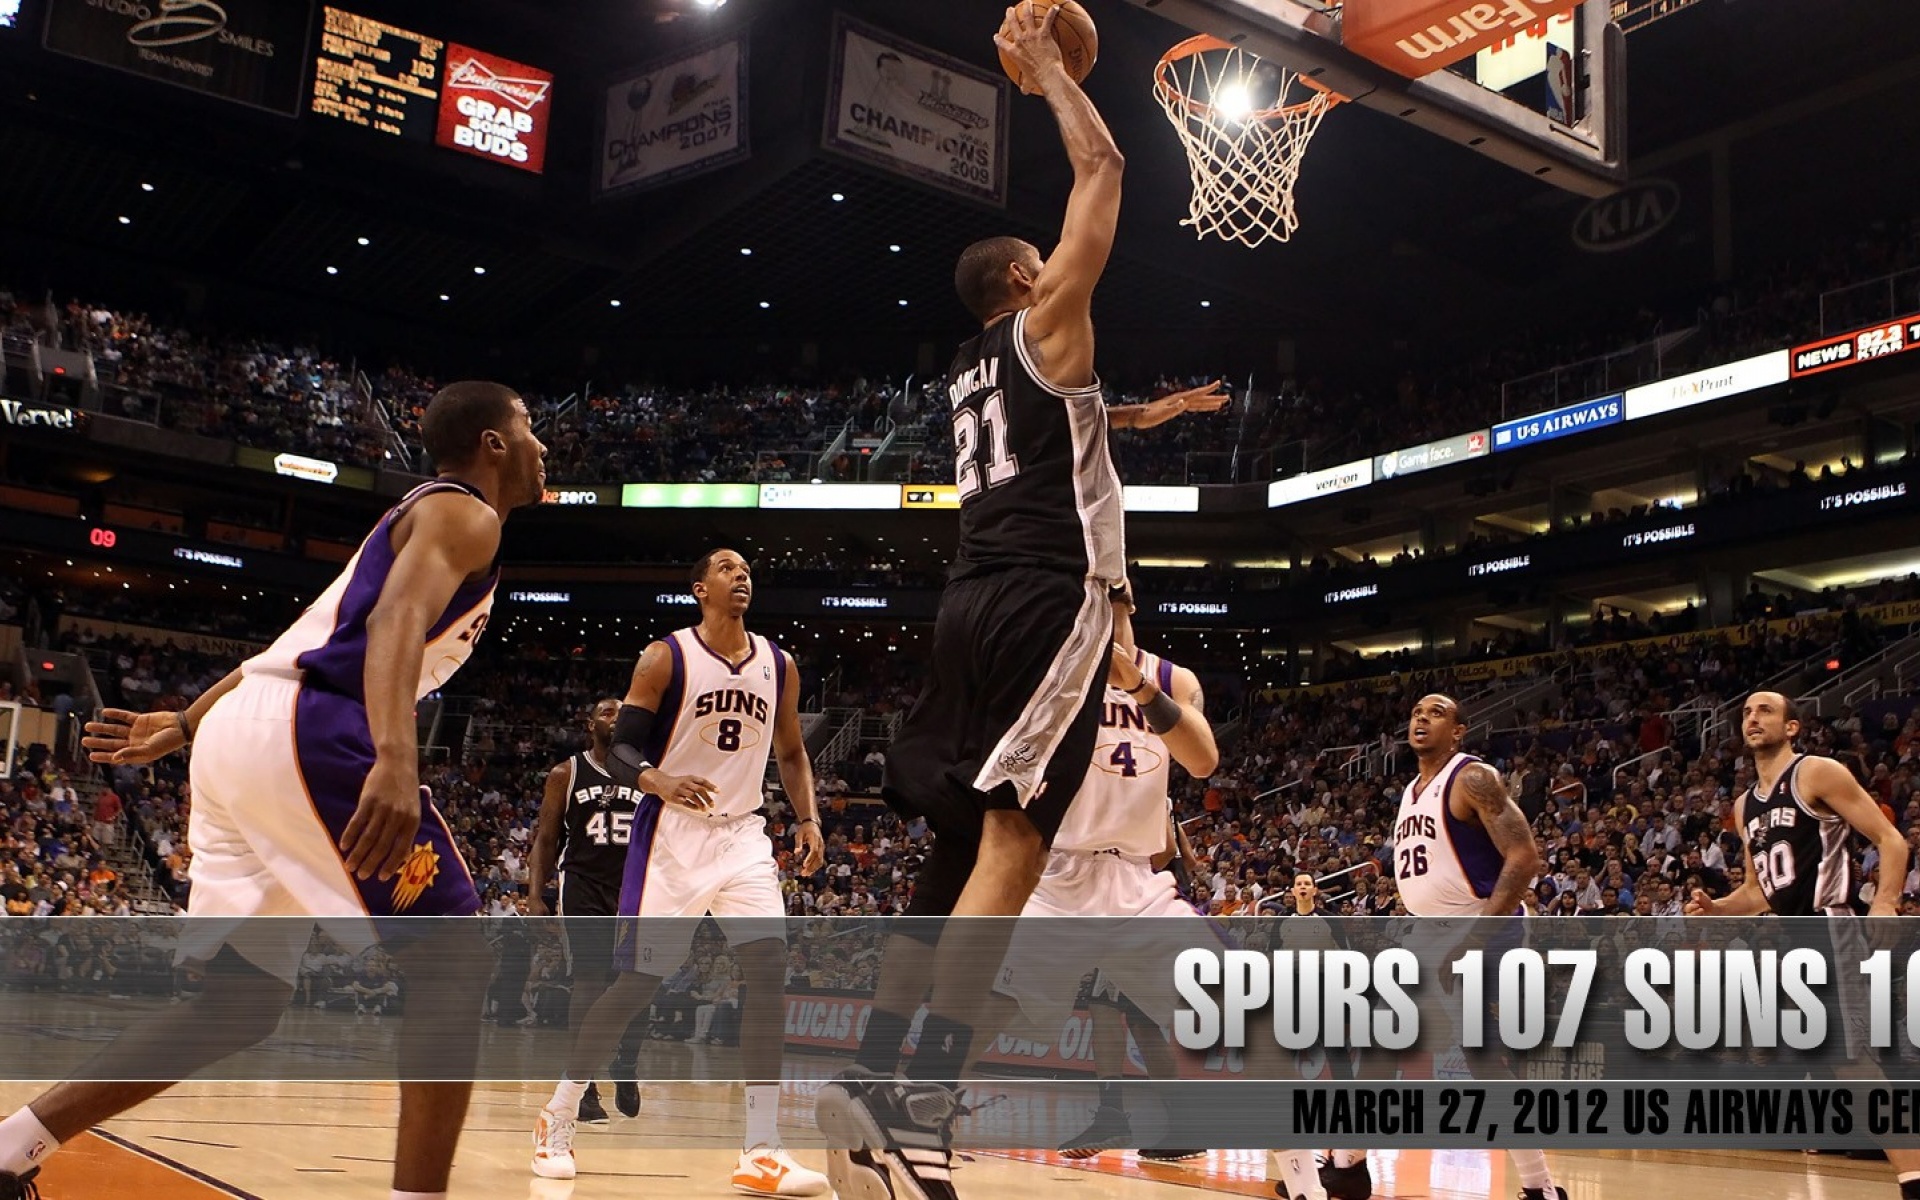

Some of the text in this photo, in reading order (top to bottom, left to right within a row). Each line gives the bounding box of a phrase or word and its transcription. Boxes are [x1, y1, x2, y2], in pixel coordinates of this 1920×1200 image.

[218, 28, 275, 57] SMILES
[1395, 0, 1537, 59] Farm
[456, 95, 533, 132] GRAB
[469, 116, 518, 141] SOME
[453, 124, 528, 162] BUDS
[608, 104, 732, 159] CHAMPIONS
[680, 123, 731, 150] 2007
[850, 103, 989, 167] CHAMPIONS
[950, 157, 989, 185] 2009
[1591, 190, 1662, 240] KIA
[1798, 343, 1851, 369] NEWS
[1542, 402, 1618, 434] AIRWAYS
[953, 390, 1020, 503] 21
[1399, 450, 1427, 469] Game
[1315, 473, 1358, 491] verizon
[1820, 483, 1906, 510] IT'S POSSIBLE
[1623, 523, 1695, 547] IT'S POSSIBLE
[194, 551, 243, 567] POSSIBLE
[1468, 555, 1530, 576] IT'S POSSIBLE
[527, 592, 570, 602] POSSIBLE
[822, 596, 887, 607] IT'S POSSIBLE
[1158, 603, 1228, 614] IT'S POSSIBLE
[1324, 584, 1378, 603] IT'S POSSIBLE
[694, 689, 768, 725] SUNS
[1100, 701, 1152, 732] UN
[717, 719, 742, 752] 8
[1110, 742, 1138, 777] 4
[586, 812, 632, 845] 45
[1400, 844, 1428, 880] 26
[1752, 840, 1796, 900] 20
[784, 1000, 854, 1042] LUCAS
